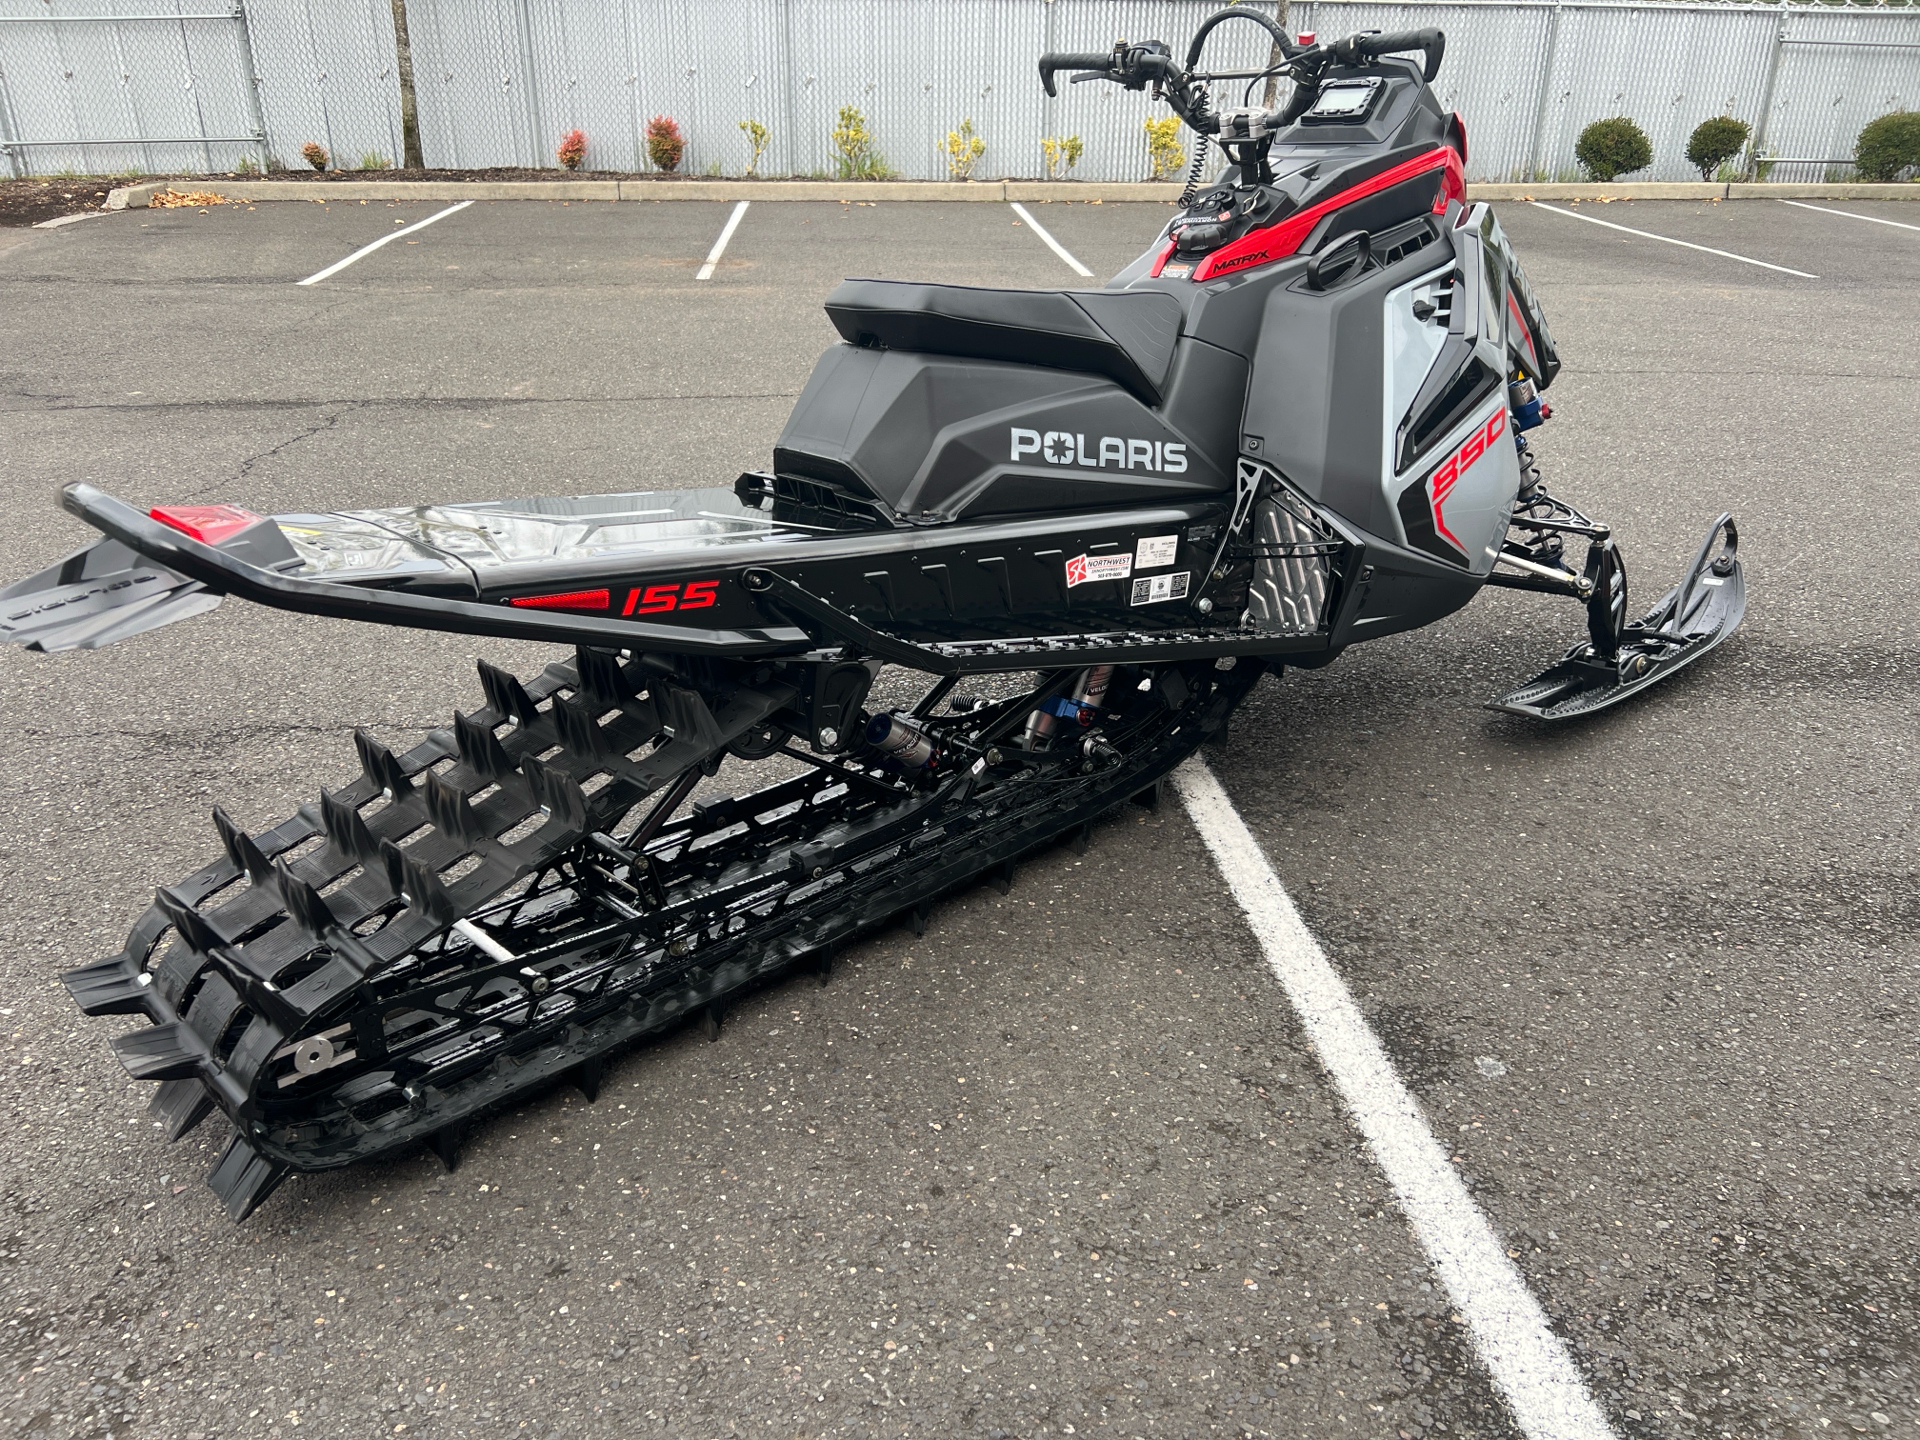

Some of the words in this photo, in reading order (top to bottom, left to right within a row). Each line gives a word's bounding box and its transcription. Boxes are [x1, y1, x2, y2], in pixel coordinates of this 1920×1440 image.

[1212, 249, 1270, 274] MATRYX
[1010, 427, 1188, 473] POLARIS
[1432, 405, 1506, 502] 850
[1087, 557, 1131, 567] NORTHWEST
[622, 581, 720, 616] 155
